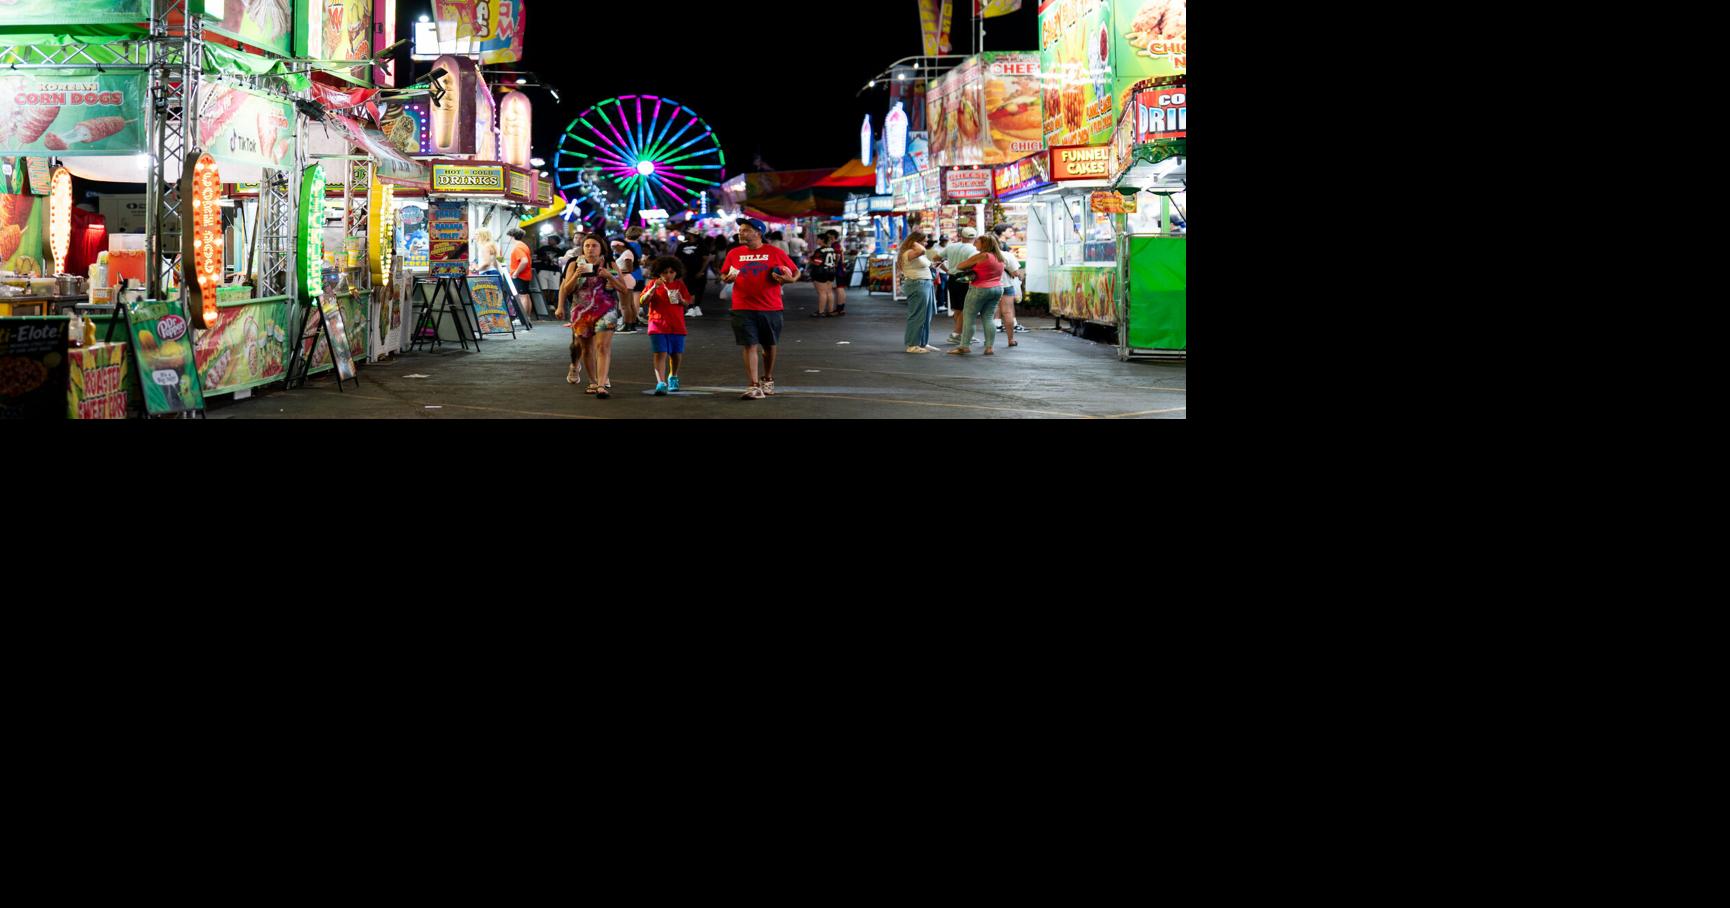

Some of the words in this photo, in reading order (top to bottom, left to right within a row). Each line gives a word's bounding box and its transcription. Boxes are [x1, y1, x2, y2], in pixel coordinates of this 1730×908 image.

[992, 63, 1040, 74] CHEE
[14, 92, 66, 105] CORN
[70, 91, 123, 105] DOGS
[1158, 93, 1186, 106] CO
[1061, 150, 1108, 162] FUNNEL
[1067, 163, 1106, 175] CAKES
[438, 175, 498, 186] DRINKS
[204, 229, 214, 273] DOG
[739, 254, 769, 262] BILLS
[159, 320, 184, 339] Pepper
